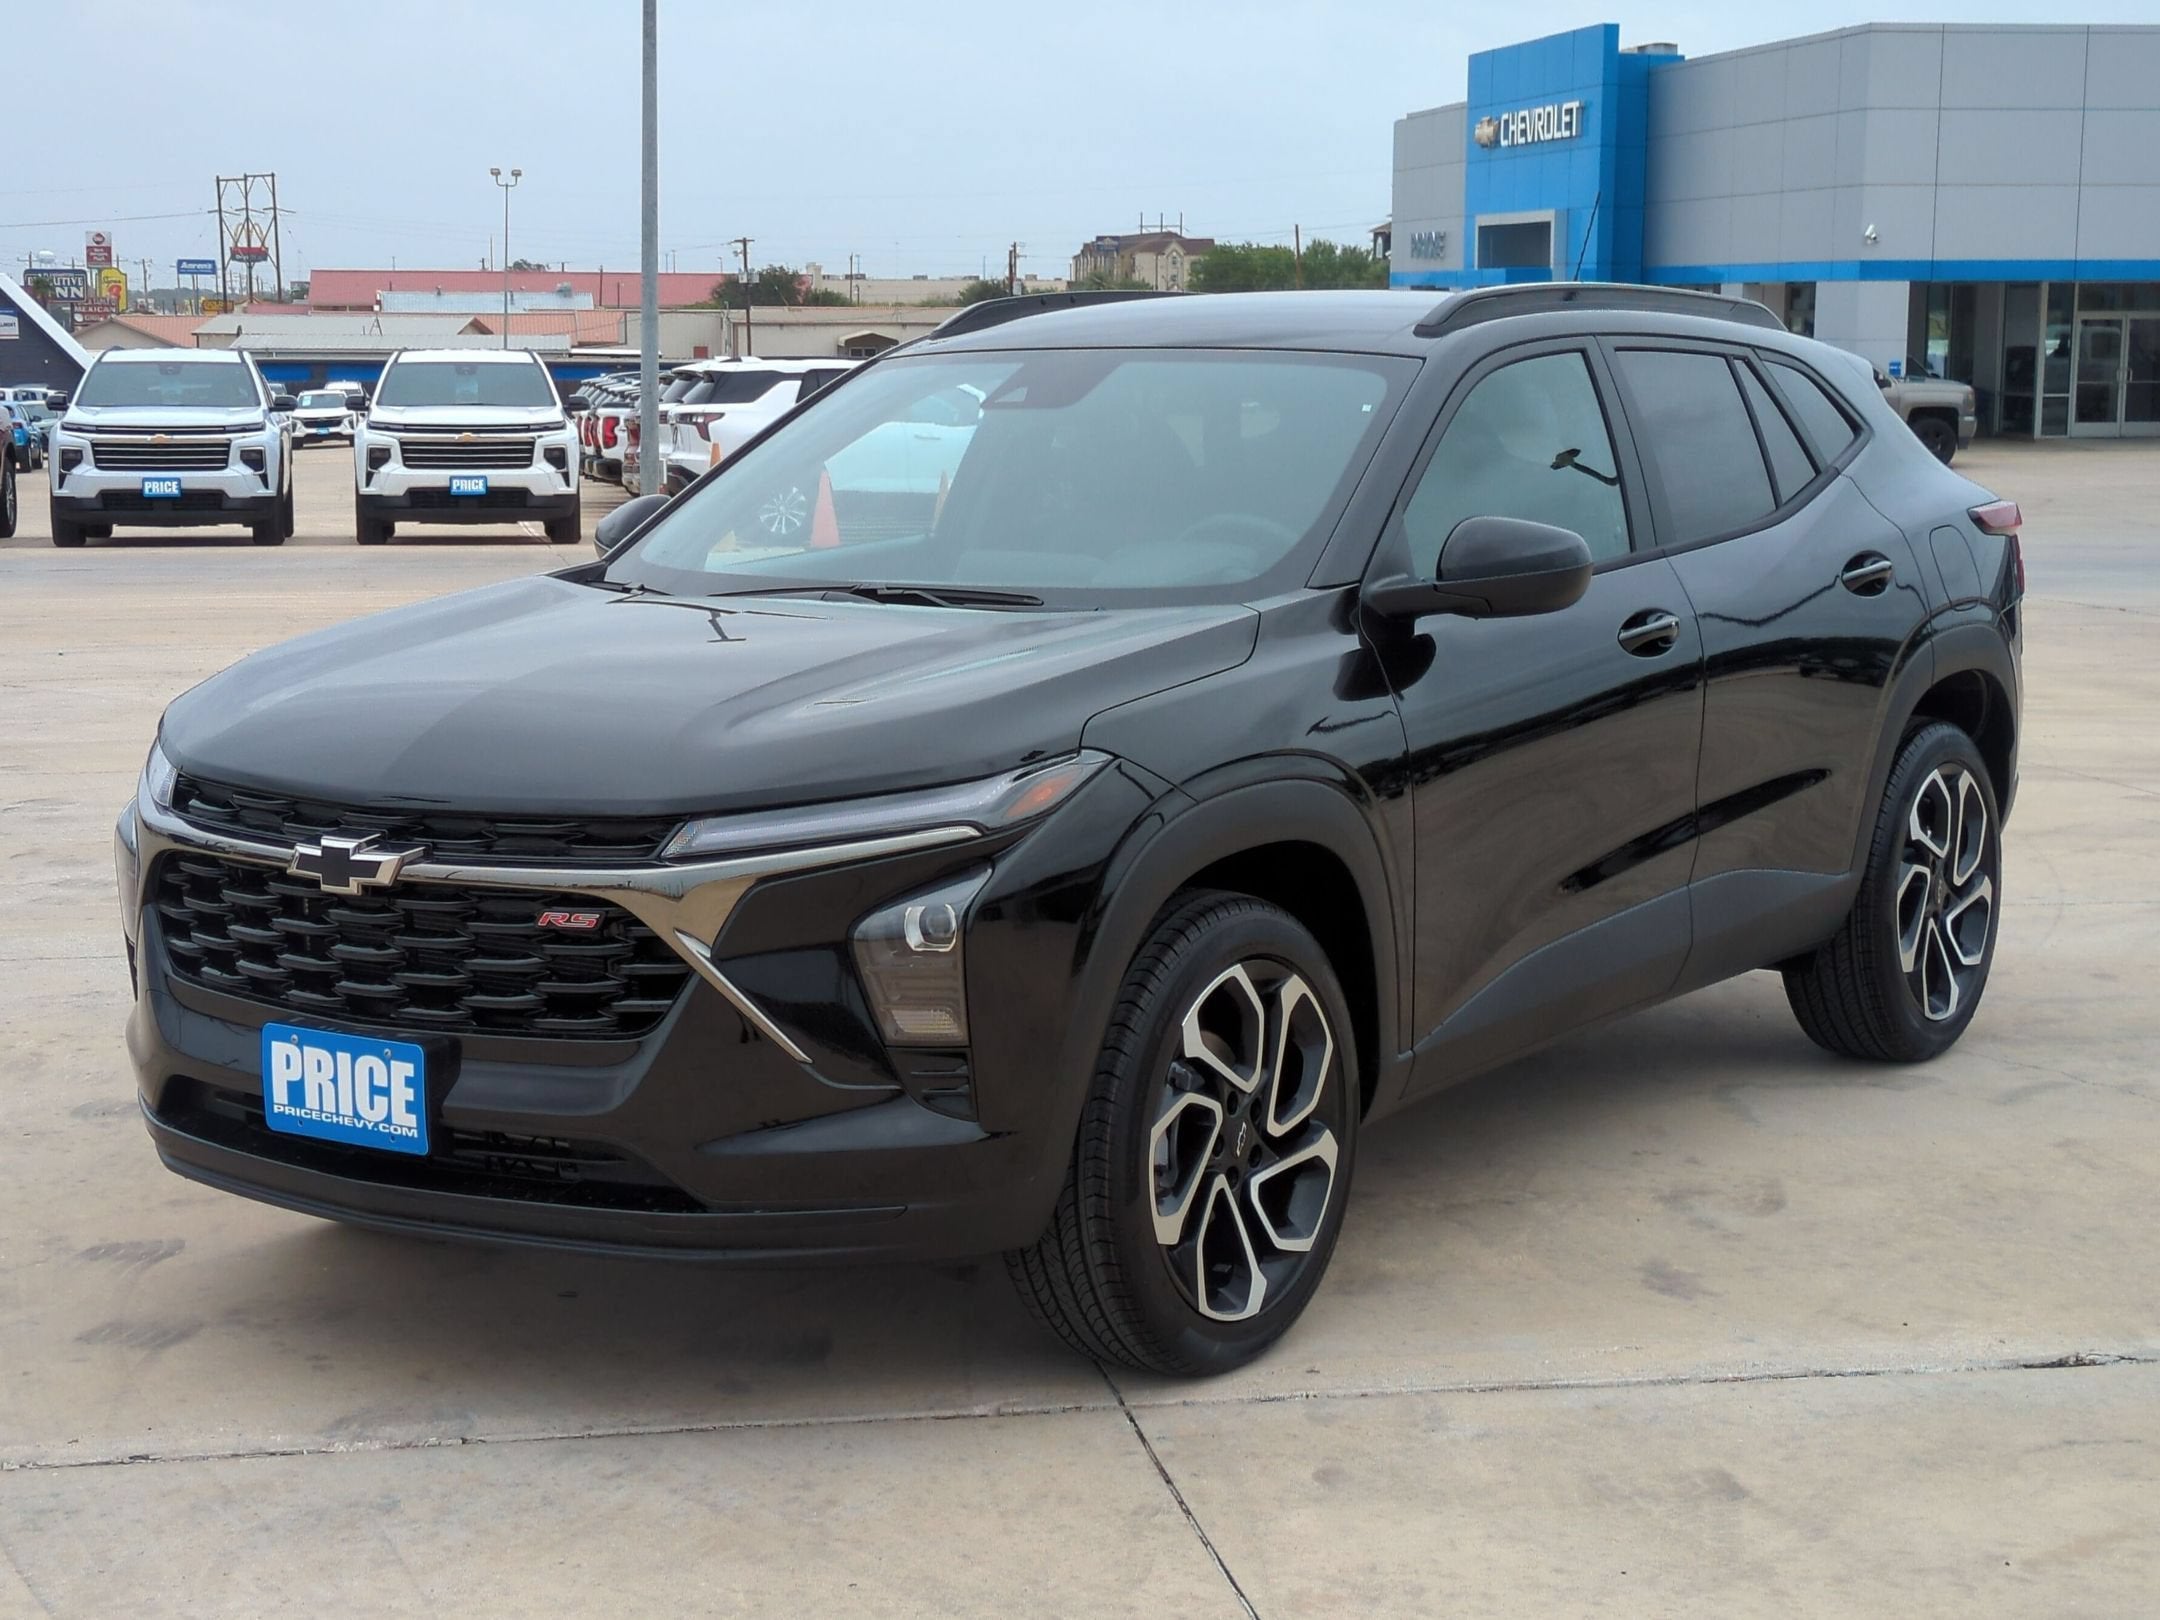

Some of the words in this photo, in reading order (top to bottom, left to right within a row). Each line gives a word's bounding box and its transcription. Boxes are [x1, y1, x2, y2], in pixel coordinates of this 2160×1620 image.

[1500, 101, 1582, 147] CHEVROLET
[27, 276, 83, 286] EUTIVE
[144, 481, 178, 494] PRICE
[452, 479, 485, 491] PRICE
[537, 911, 600, 928] RS
[271, 1040, 417, 1127] PRICE
[273, 1103, 419, 1138] PRICECHEVY.COM
